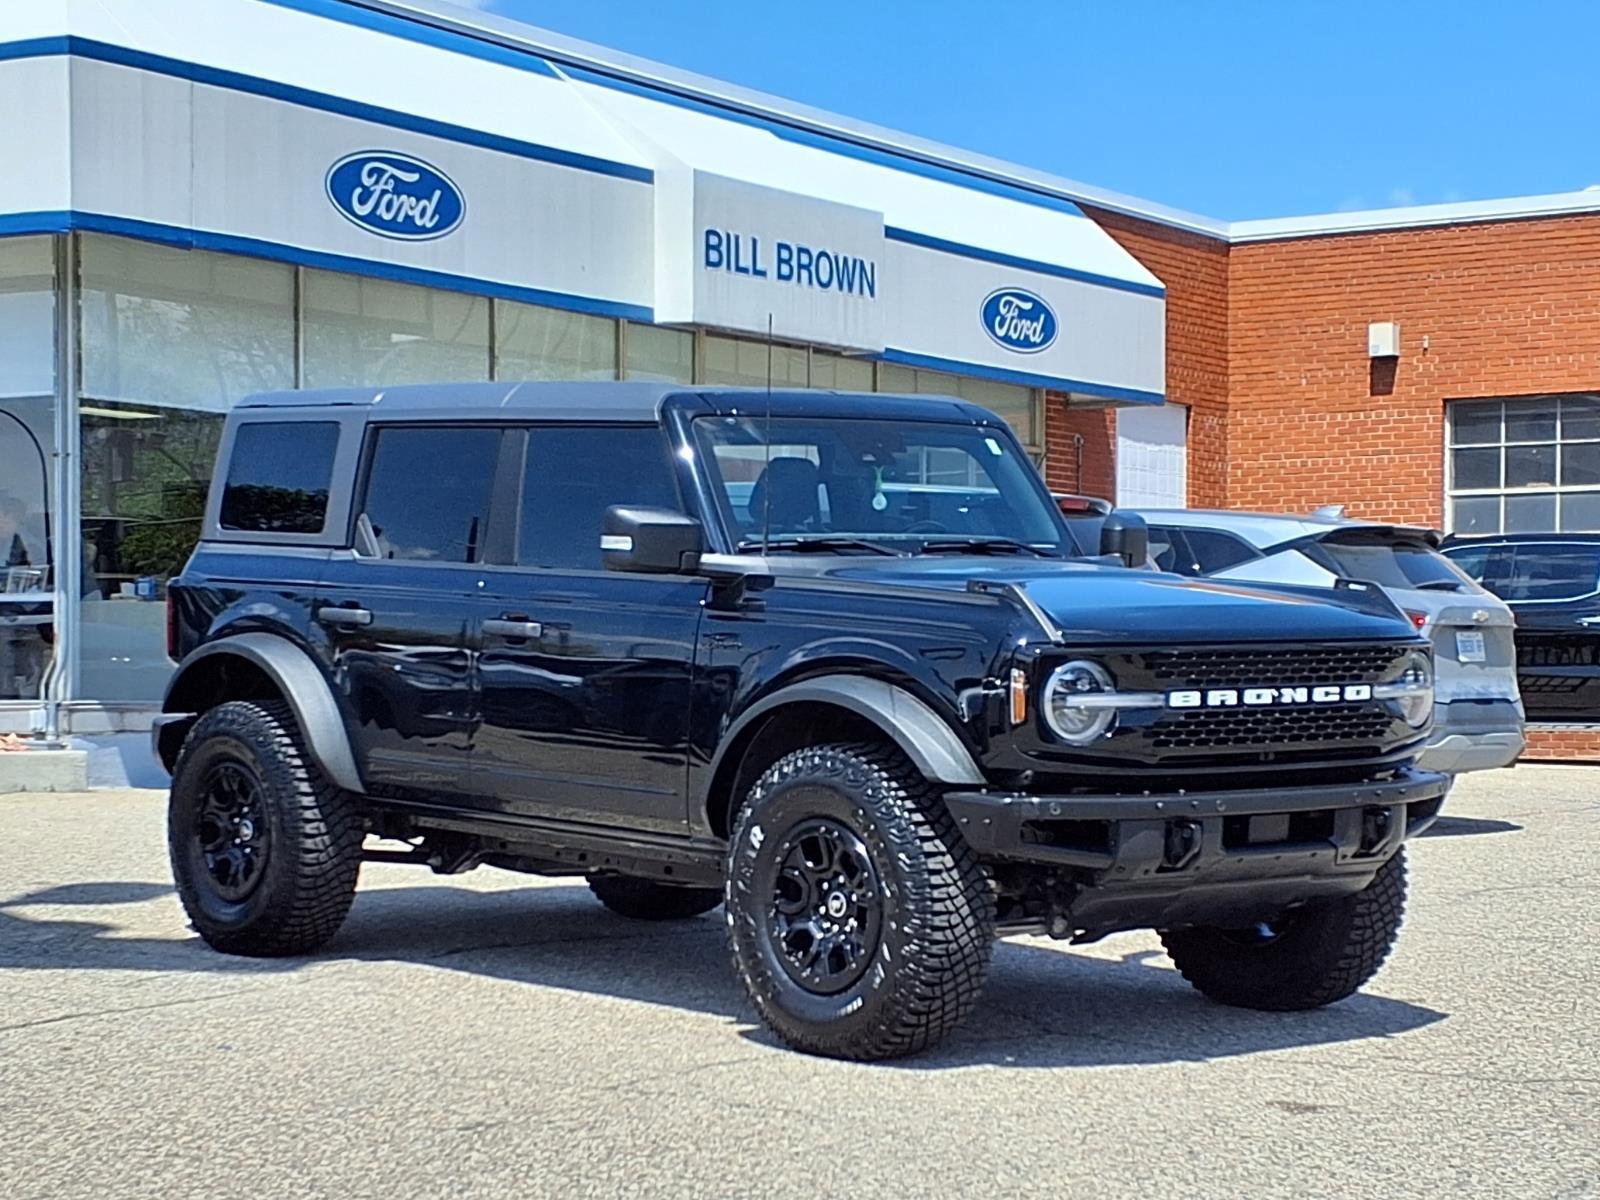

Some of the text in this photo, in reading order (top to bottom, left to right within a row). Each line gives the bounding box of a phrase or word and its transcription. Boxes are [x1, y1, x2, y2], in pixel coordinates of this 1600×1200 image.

[352, 161, 441, 228] Ford
[704, 229, 875, 298] BILL BROWN
[994, 295, 1045, 343] Ford
[1169, 685, 1371, 708] BRONCO
